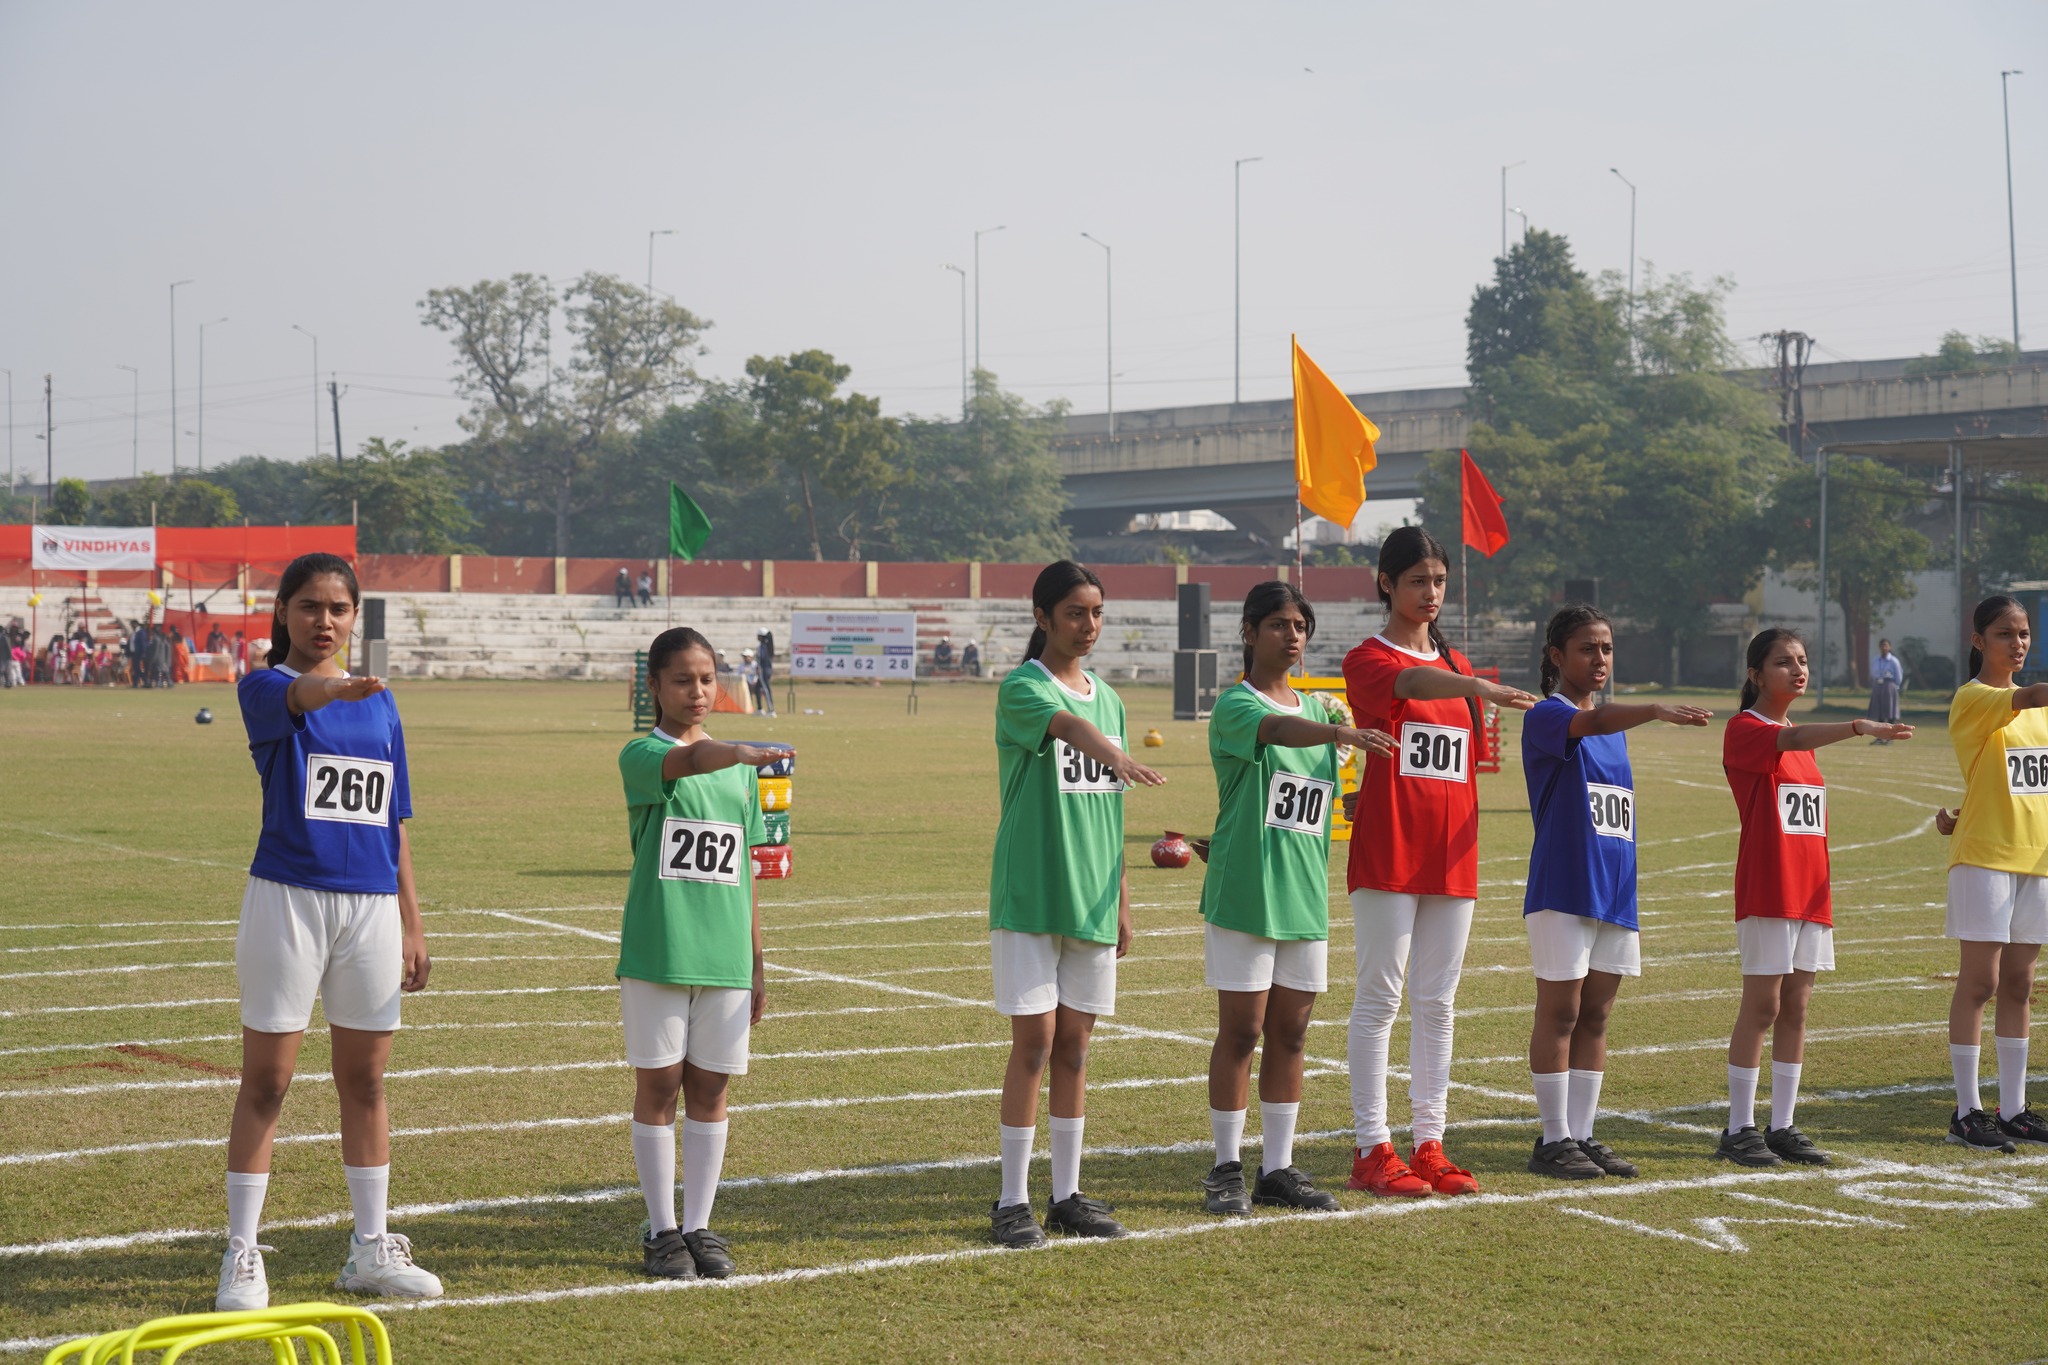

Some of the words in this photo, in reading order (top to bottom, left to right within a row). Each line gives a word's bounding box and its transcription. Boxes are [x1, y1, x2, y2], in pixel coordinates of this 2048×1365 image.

[64, 540, 151, 553] VINDHYAS
[1409, 731, 1462, 773] 301
[314, 766, 385, 815] 260
[1274, 781, 1323, 826] 310
[1588, 791, 1630, 832] 306
[1785, 792, 1821, 828] 261
[669, 828, 736, 875] 262
